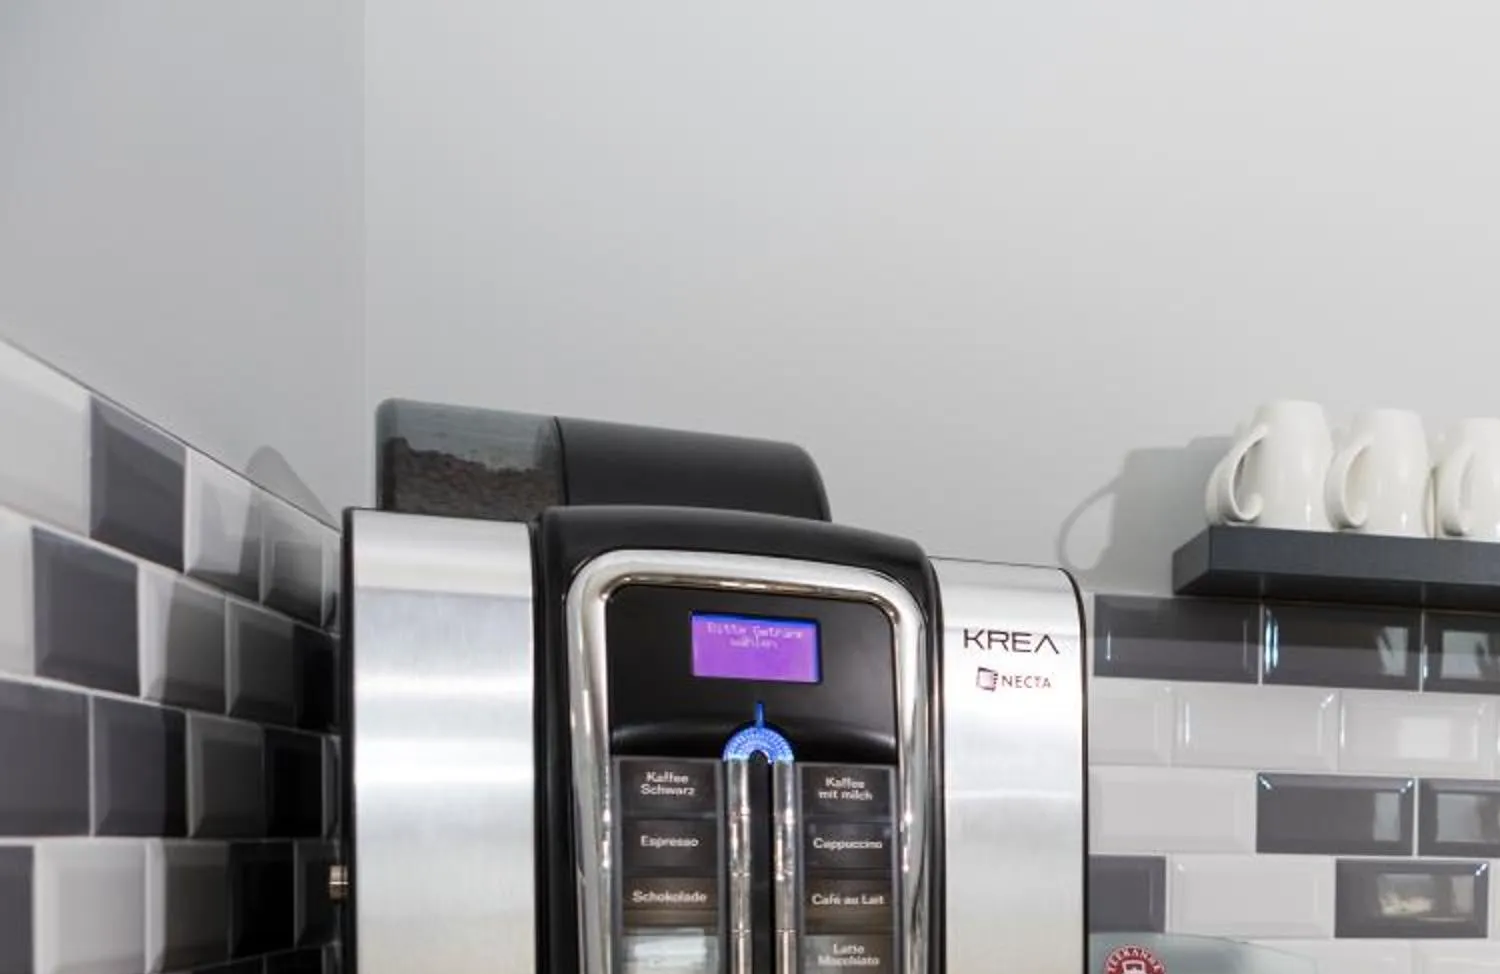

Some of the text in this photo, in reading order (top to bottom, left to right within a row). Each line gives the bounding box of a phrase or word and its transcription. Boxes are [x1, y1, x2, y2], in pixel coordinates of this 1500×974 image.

[963, 628, 1060, 655] KREA
[1001, 675, 1051, 688] NECTA
[645, 771, 689, 784] Kaffee
[825, 777, 865, 789] Kaffee
[640, 783, 695, 796] Schwarz
[818, 790, 873, 801] mit milch
[640, 835, 700, 849] Espresso
[813, 837, 883, 851] Cappuccino
[632, 889, 708, 903] Schokolade
[861, 894, 885, 905] Lait
